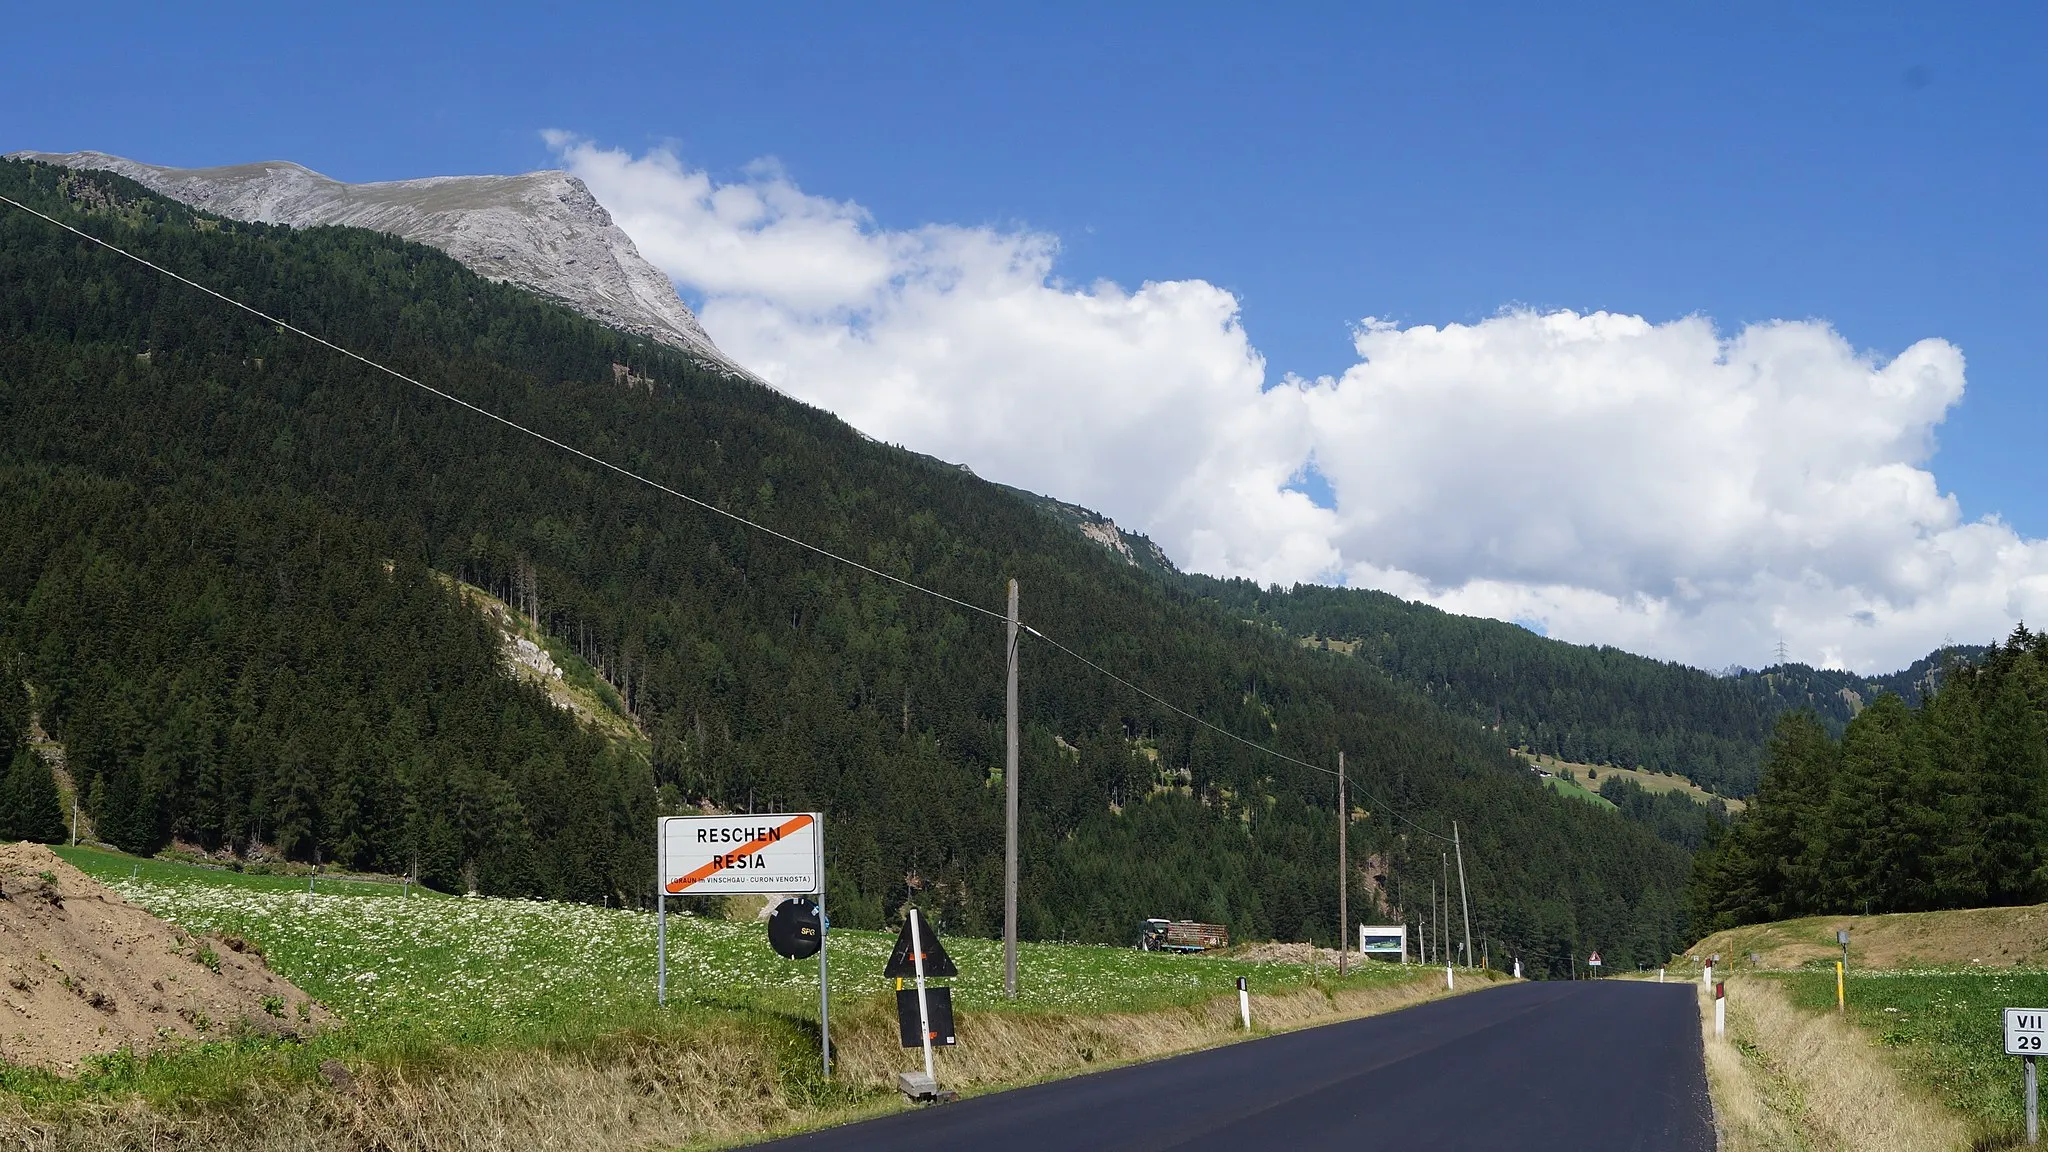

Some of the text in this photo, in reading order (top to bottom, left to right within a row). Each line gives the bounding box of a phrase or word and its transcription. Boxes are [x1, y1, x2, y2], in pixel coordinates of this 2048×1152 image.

[697, 827, 781, 843] RESCHEN
[713, 854, 766, 870] RESIA
[706, 876, 746, 884] VINSCHGAU
[775, 875, 811, 883] VENOSTA)
[2017, 1015, 2042, 1029] VII
[2017, 1036, 2042, 1050] 29
